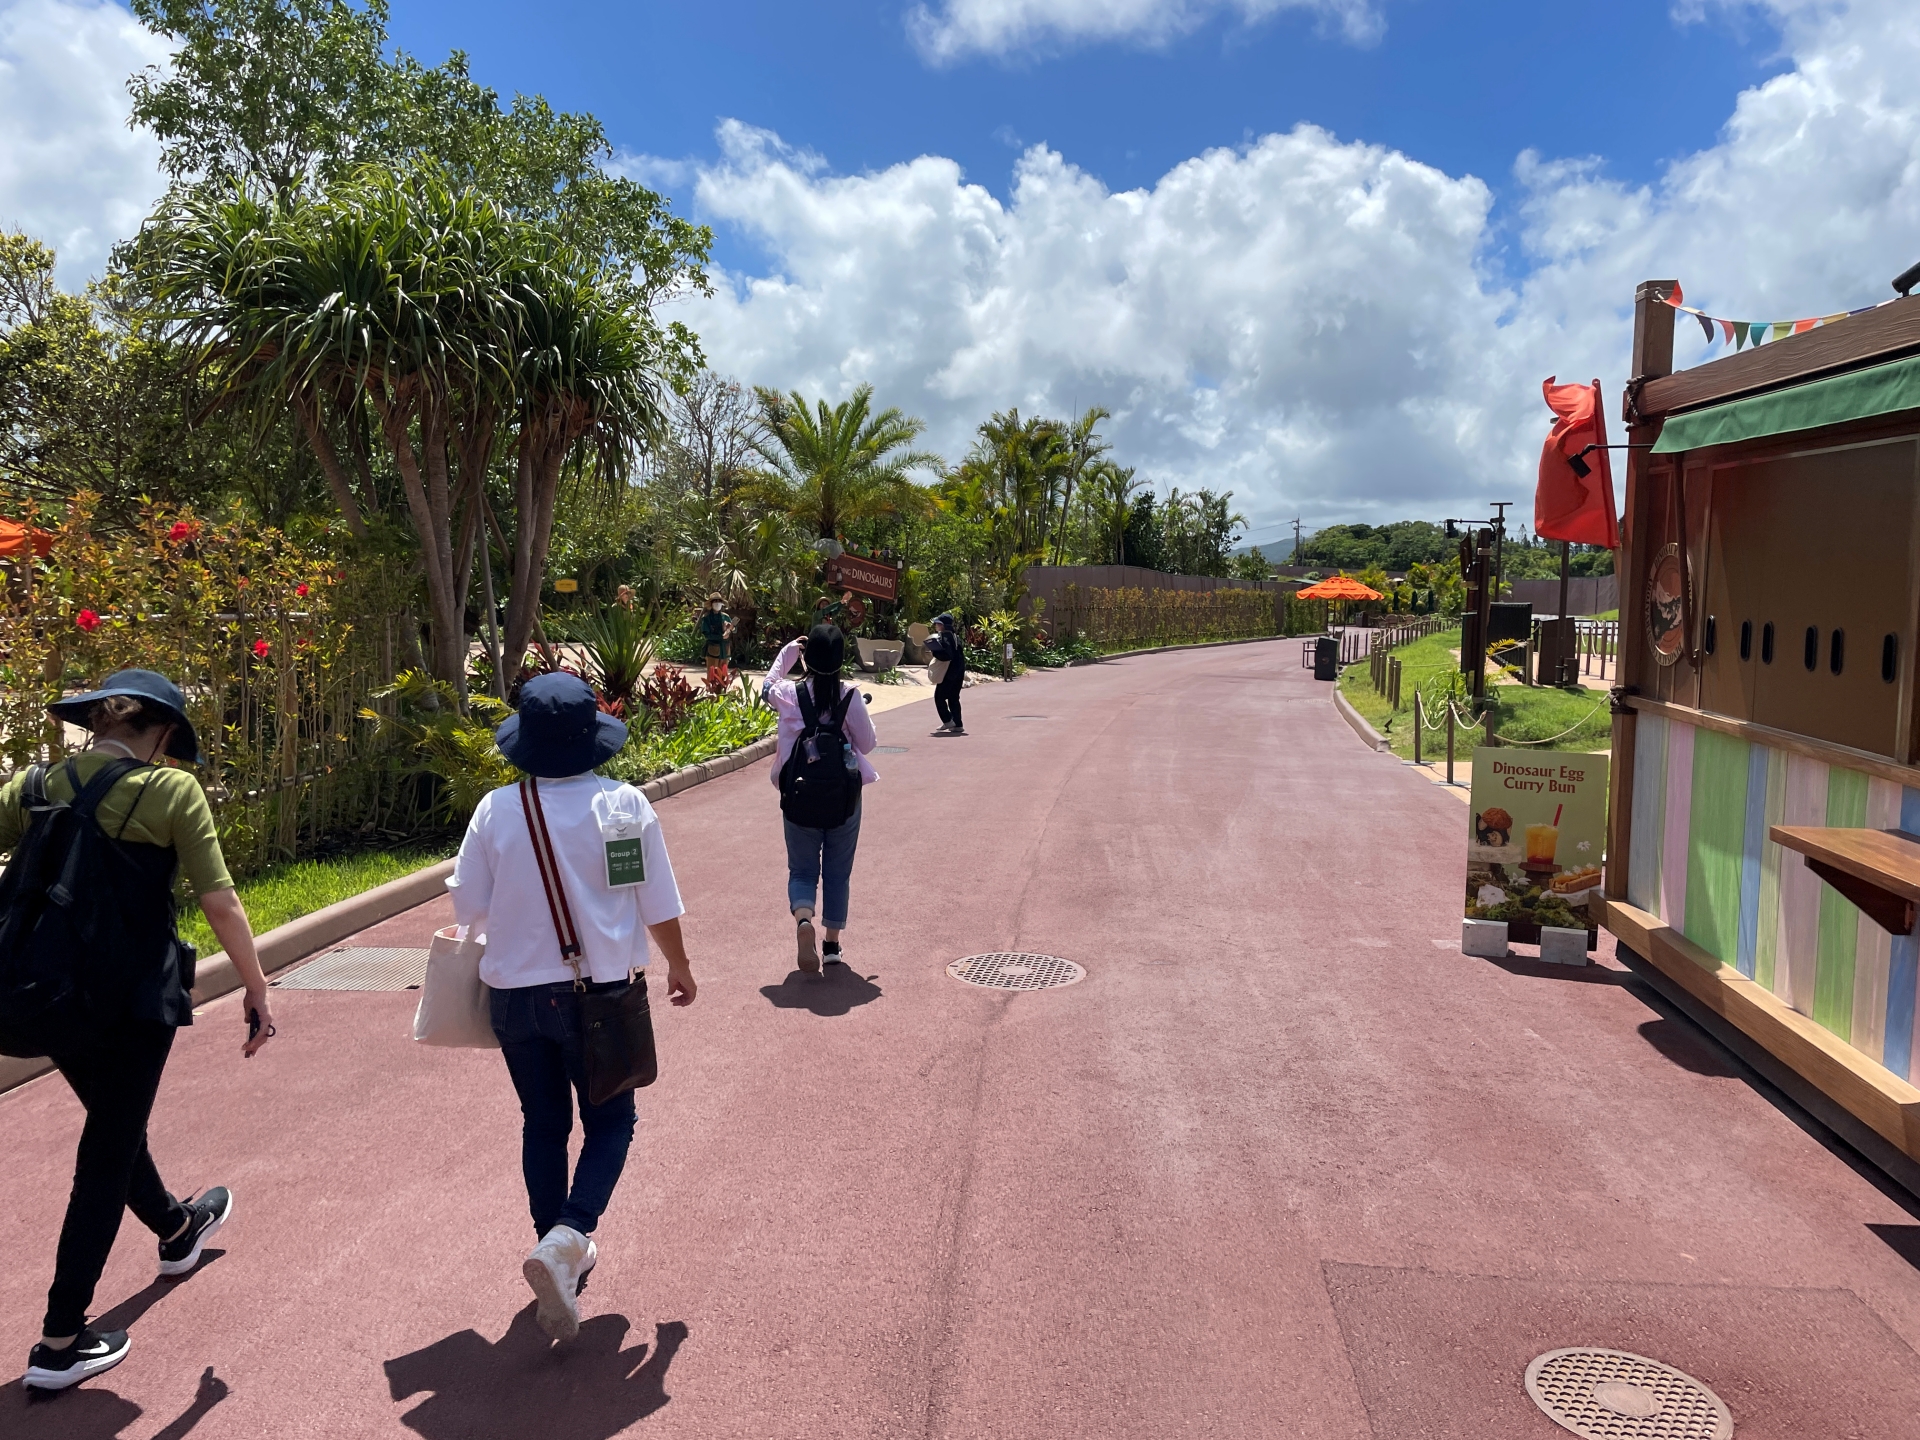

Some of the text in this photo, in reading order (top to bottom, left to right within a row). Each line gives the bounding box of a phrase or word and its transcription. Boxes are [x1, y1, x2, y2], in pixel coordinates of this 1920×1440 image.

[852, 568, 892, 588] DINOSAURS
[1493, 761, 1585, 782] Dinosaur Egg
[1504, 777, 1576, 793] Curry Bun
